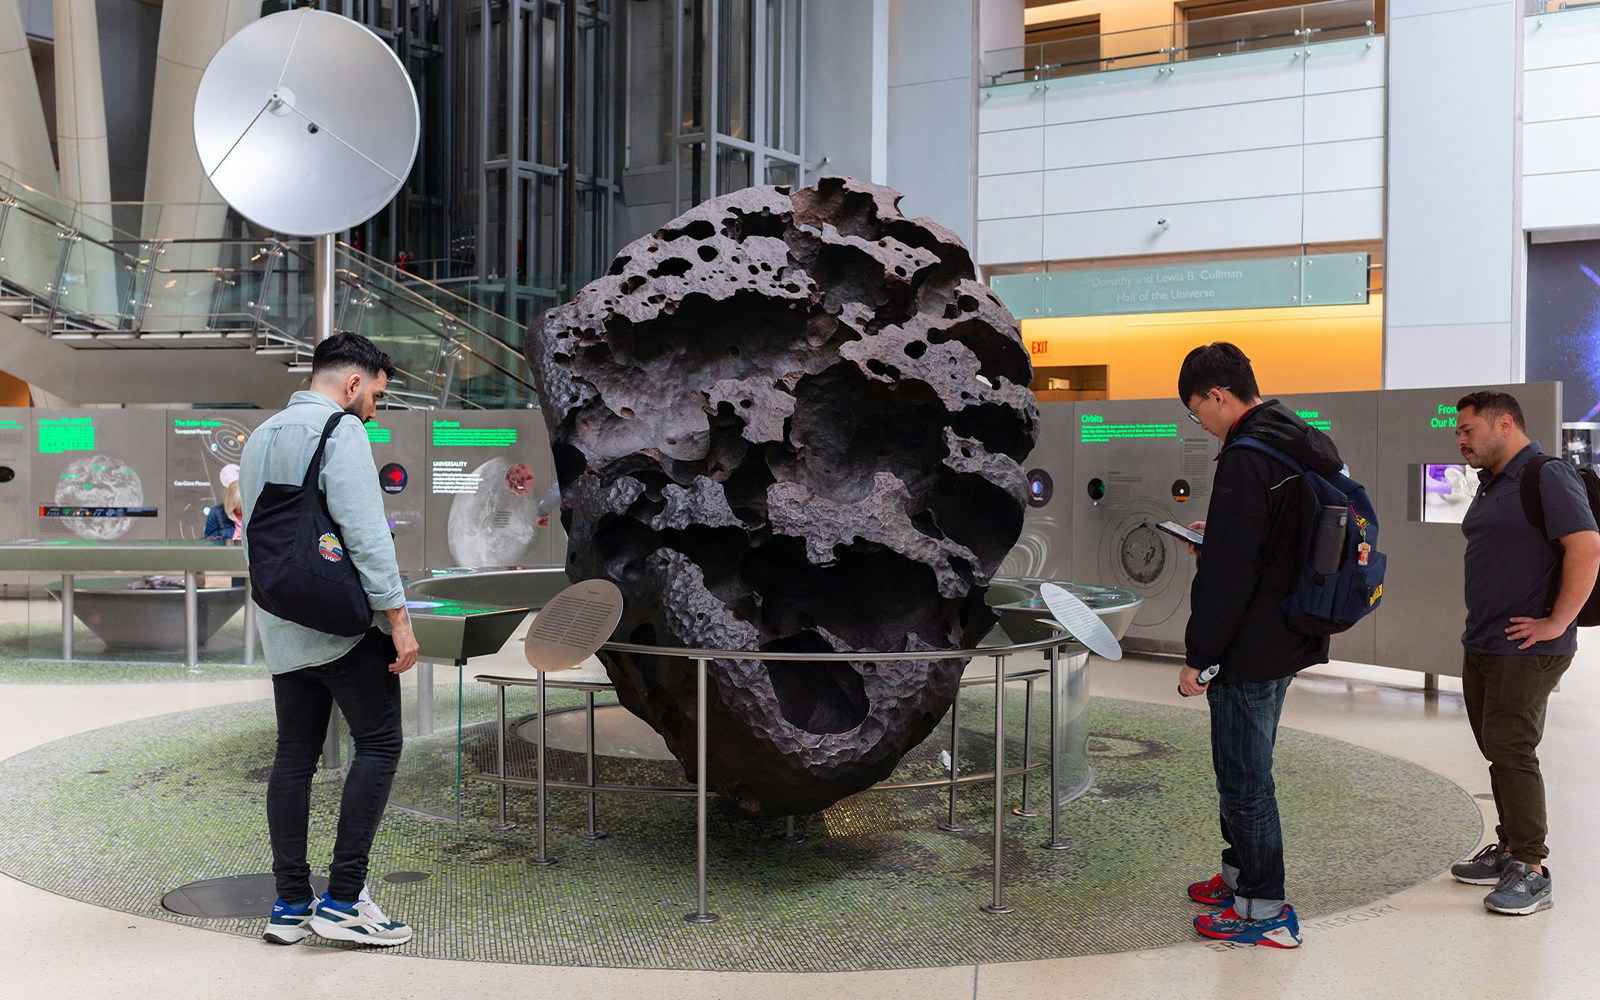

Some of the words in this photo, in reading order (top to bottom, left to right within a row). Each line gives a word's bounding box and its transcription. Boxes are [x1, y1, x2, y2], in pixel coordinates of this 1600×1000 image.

[1091, 276, 1132, 288] Dorothy
[1135, 273, 1153, 285] and
[1156, 272, 1184, 284] Lewis
[1187, 271, 1196, 281] B.
[1200, 269, 1243, 281] Cullman
[1116, 293, 1136, 303] Hall
[1138, 291, 1149, 302] of
[1152, 290, 1168, 301] the
[1170, 288, 1216, 300] Universe
[1031, 340, 1048, 355] EXIT
[432, 419, 460, 428] Surfaces
[1081, 414, 1104, 424] Orbits
[1430, 416, 1448, 428] Our
[432, 460, 468, 468] UNIVERSALITY
[1303, 903, 1401, 933] MERCURY
